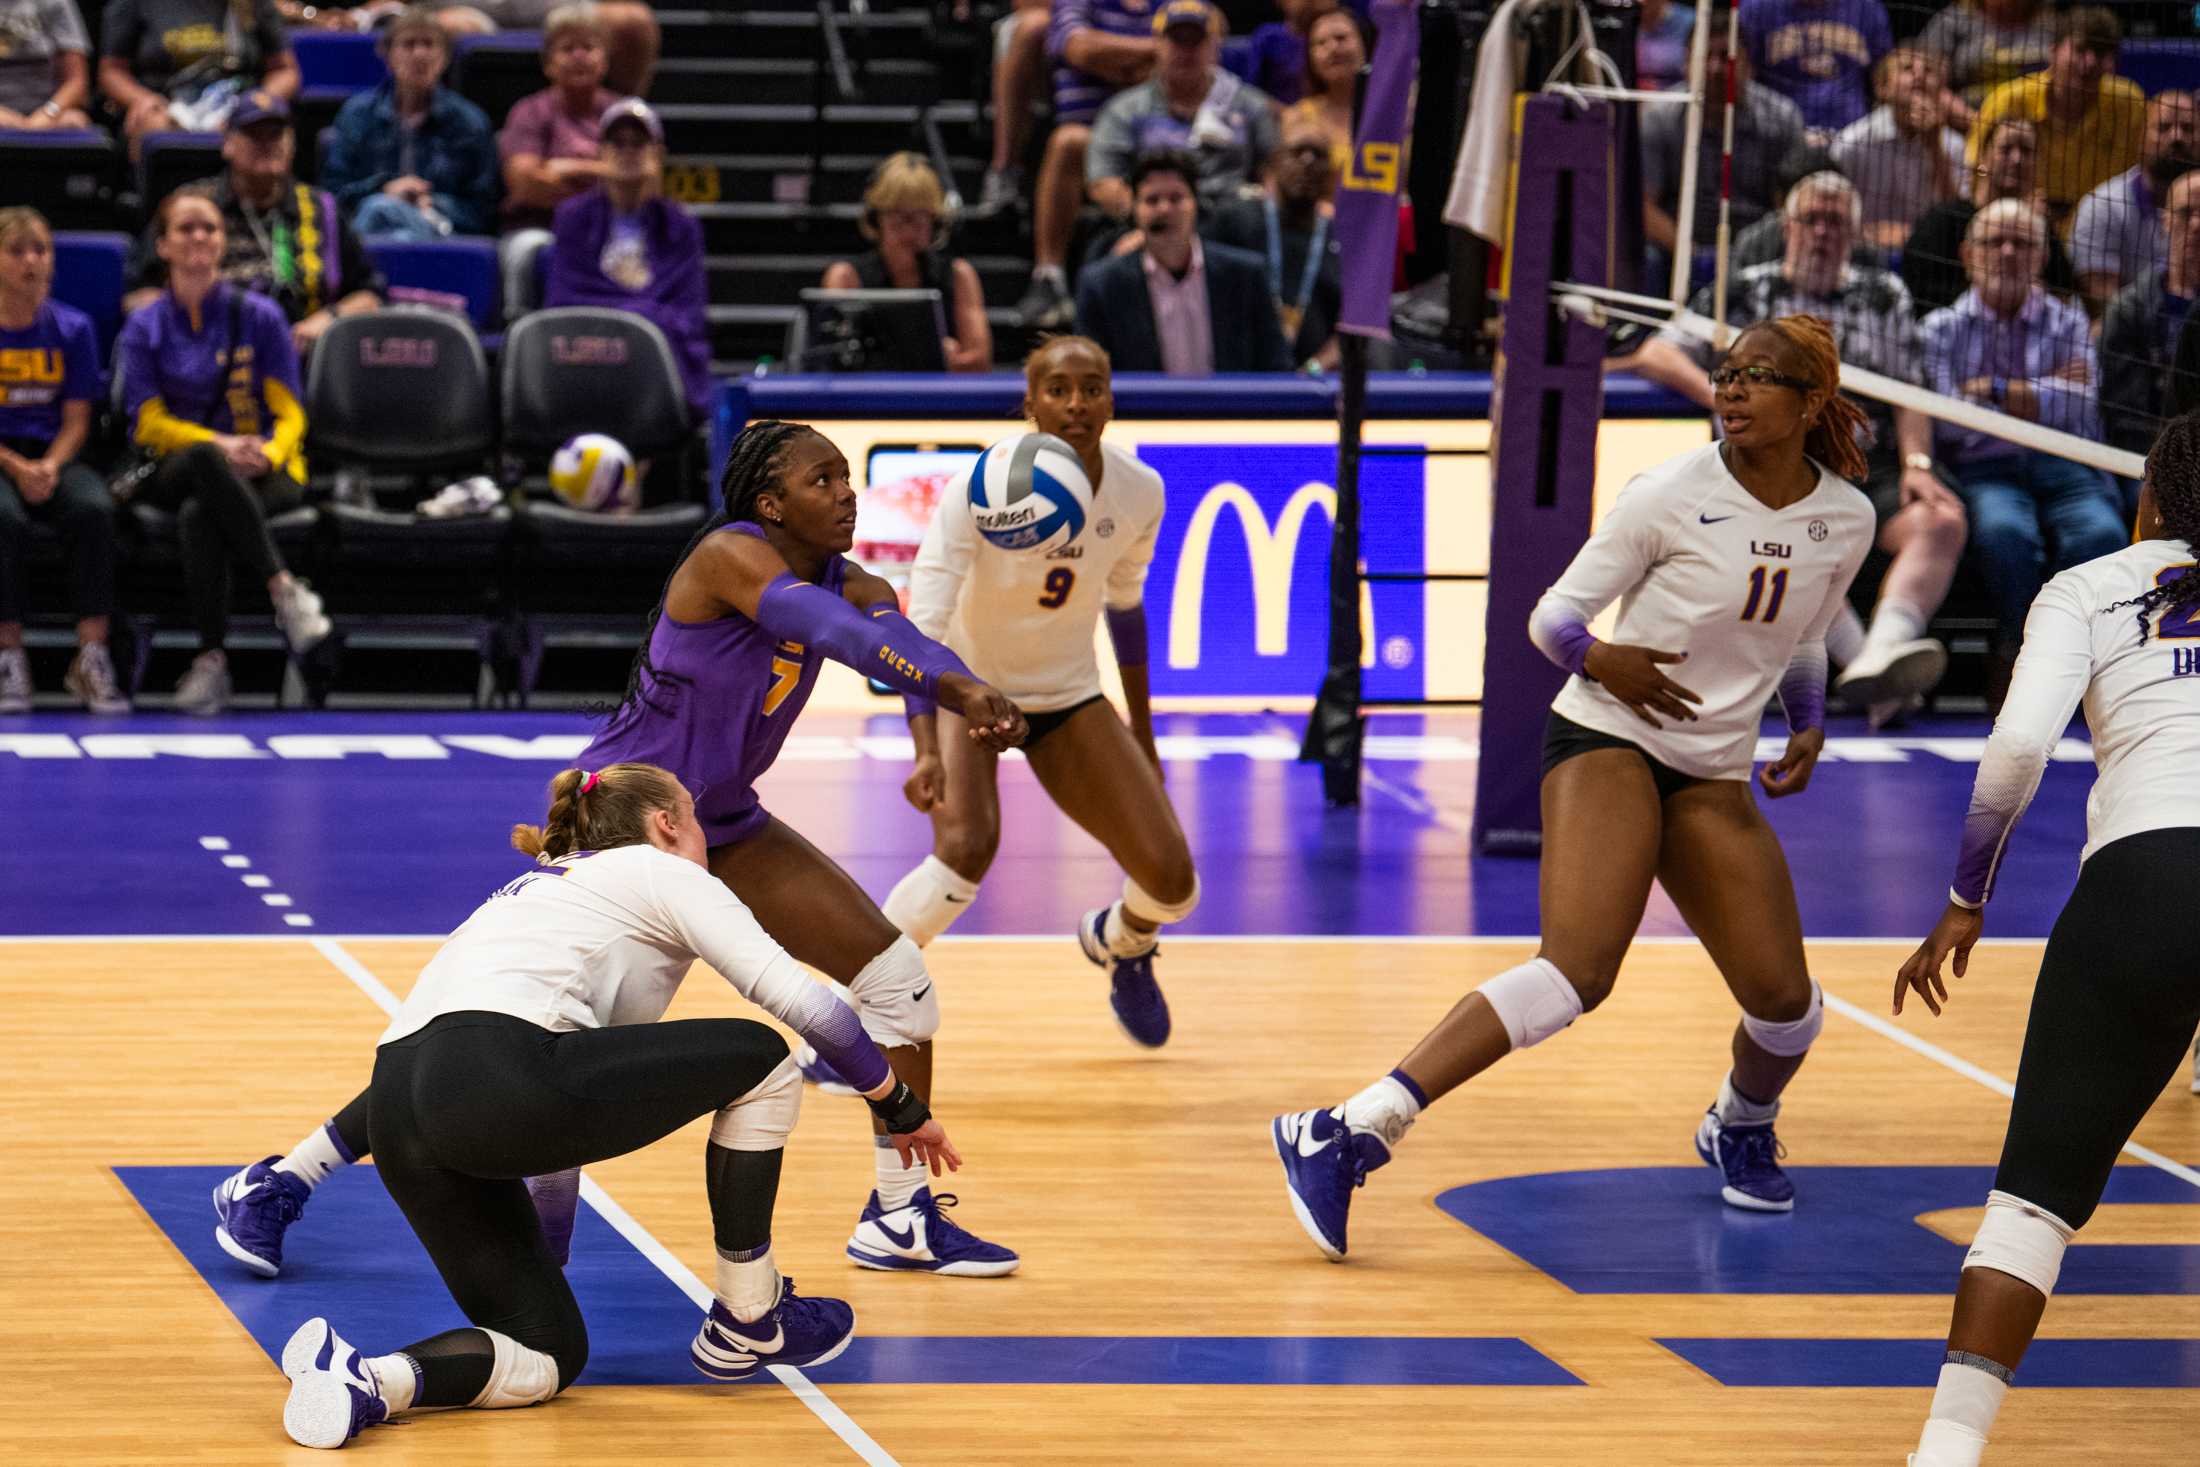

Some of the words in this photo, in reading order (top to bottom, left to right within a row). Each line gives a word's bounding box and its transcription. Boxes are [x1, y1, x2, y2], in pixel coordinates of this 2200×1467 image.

[0, 349, 64, 384] SU
[1750, 540, 1792, 559] LSU
[1038, 566, 1075, 610] 9
[1740, 565, 1790, 624] 11
[762, 655, 803, 717] 7
